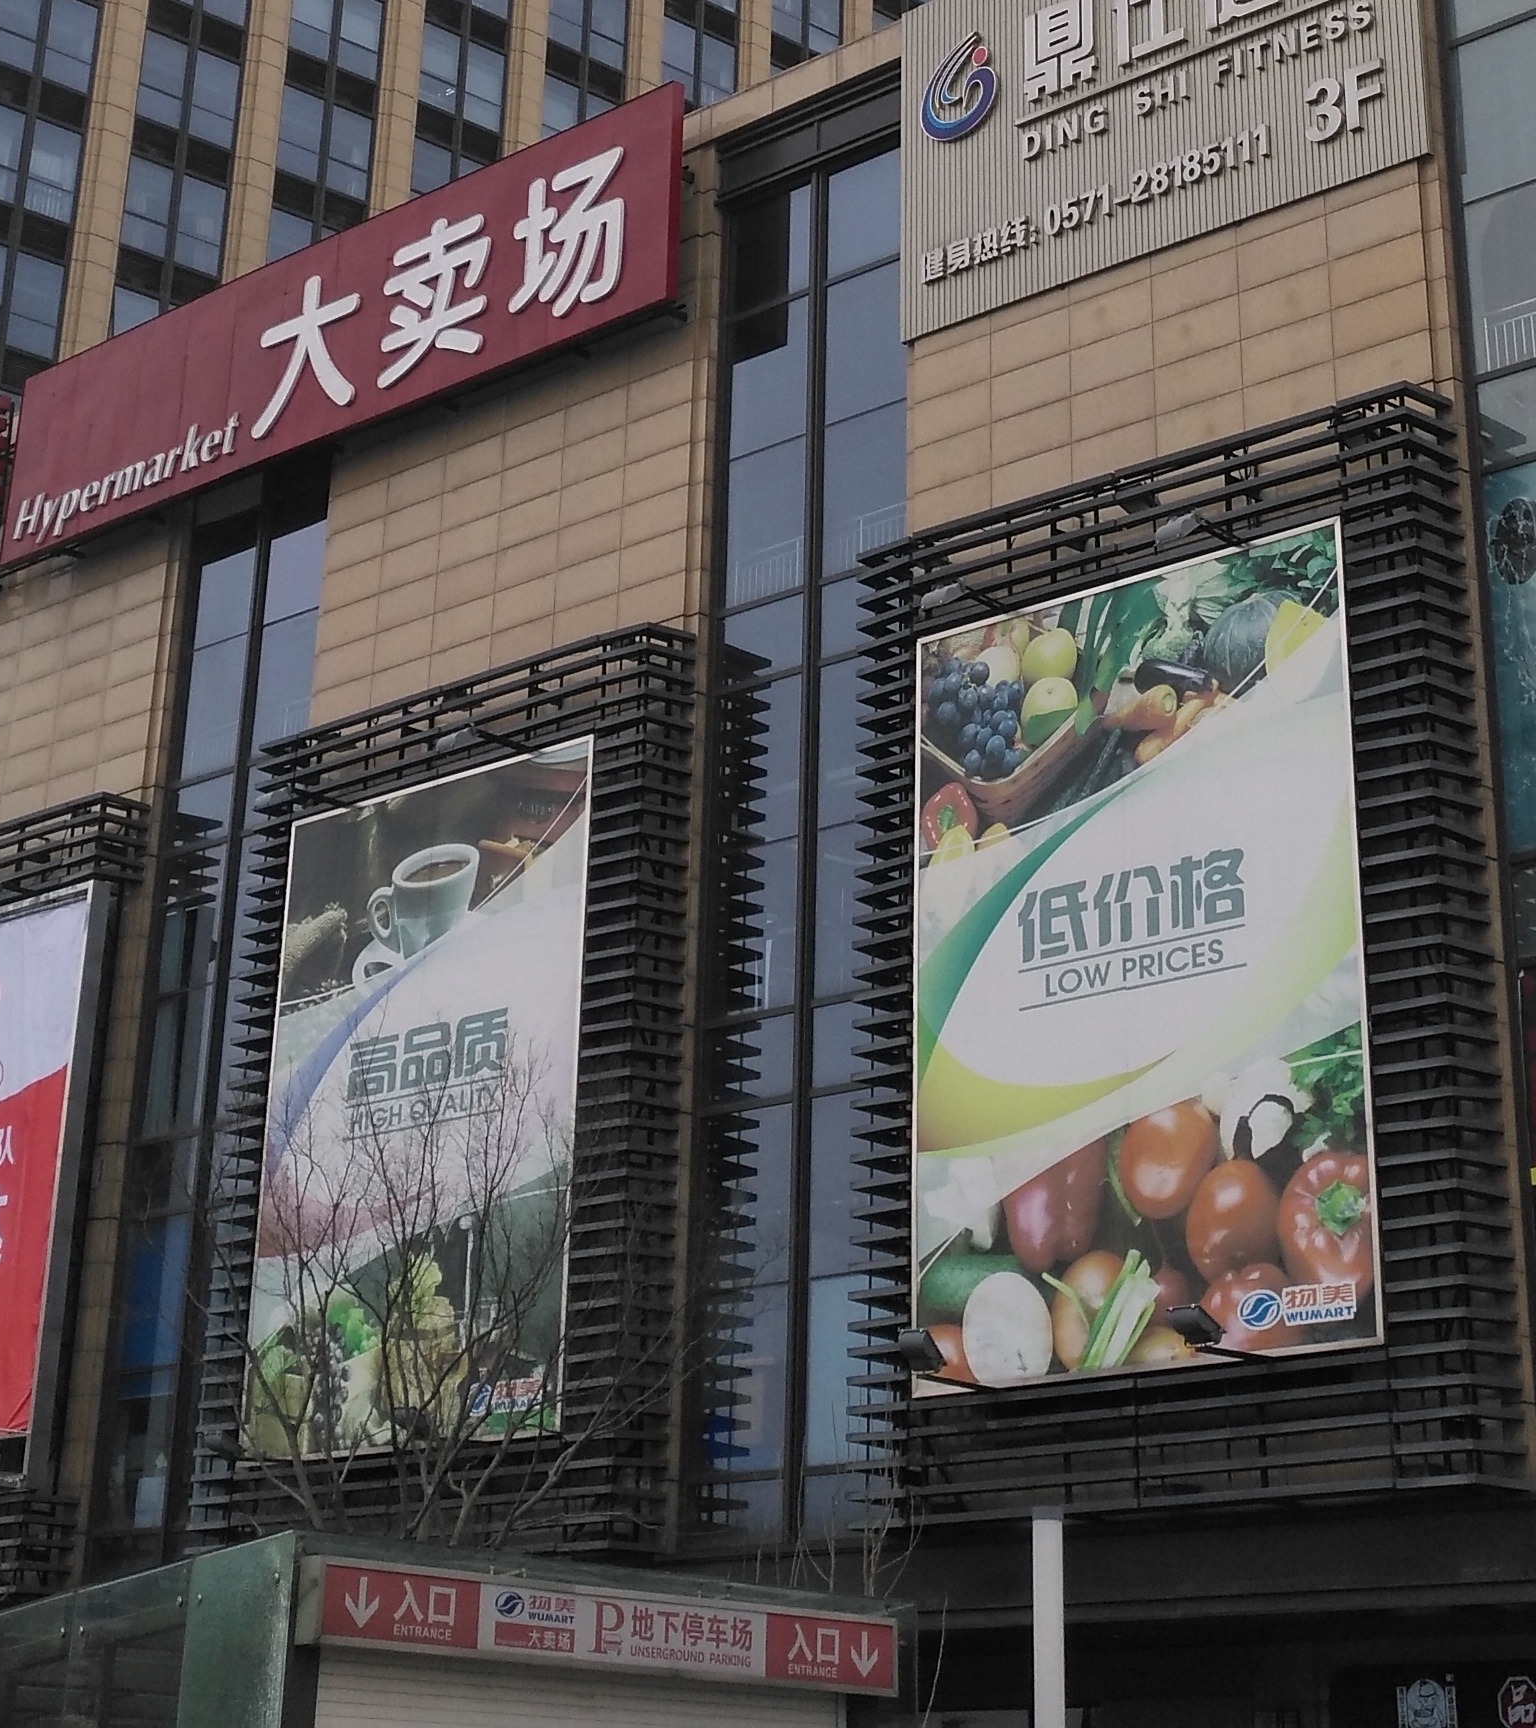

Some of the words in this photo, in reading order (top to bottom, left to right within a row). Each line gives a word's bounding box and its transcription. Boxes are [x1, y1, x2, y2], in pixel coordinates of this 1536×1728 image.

[1023, 104, 1109, 161] DING
[1135, 70, 1191, 117] SHI
[1216, 0, 1373, 87] FITNESS
[1305, 58, 1385, 143] 3F
[251, 145, 625, 440] 大卖场
[12, 412, 240, 542] Hypermarket
[1017, 847, 1246, 964] 低价格
[1045, 961, 1111, 997] LOW
[1122, 939, 1224, 982] PRICES
[346, 1007, 509, 1102] 高品质
[351, 1103, 403, 1134] HIGH
[410, 1084, 500, 1121] QUALITY
[1285, 1283, 1354, 1309] 物美
[1286, 1306, 1354, 1323] WUMART
[393, 1580, 457, 1626] 入口
[528, 1594, 576, 1613] 物美
[528, 1611, 575, 1625] WUMART
[393, 1623, 452, 1641] ENTRANCE
[527, 1629, 572, 1651] 大卖场
[631, 1605, 753, 1652] 地下停车场
[787, 1623, 840, 1665] 入口
[630, 1645, 705, 1664] UNSERGROUND
[709, 1651, 752, 1669] PARKING
[787, 1663, 838, 1679] ENTRANCE
